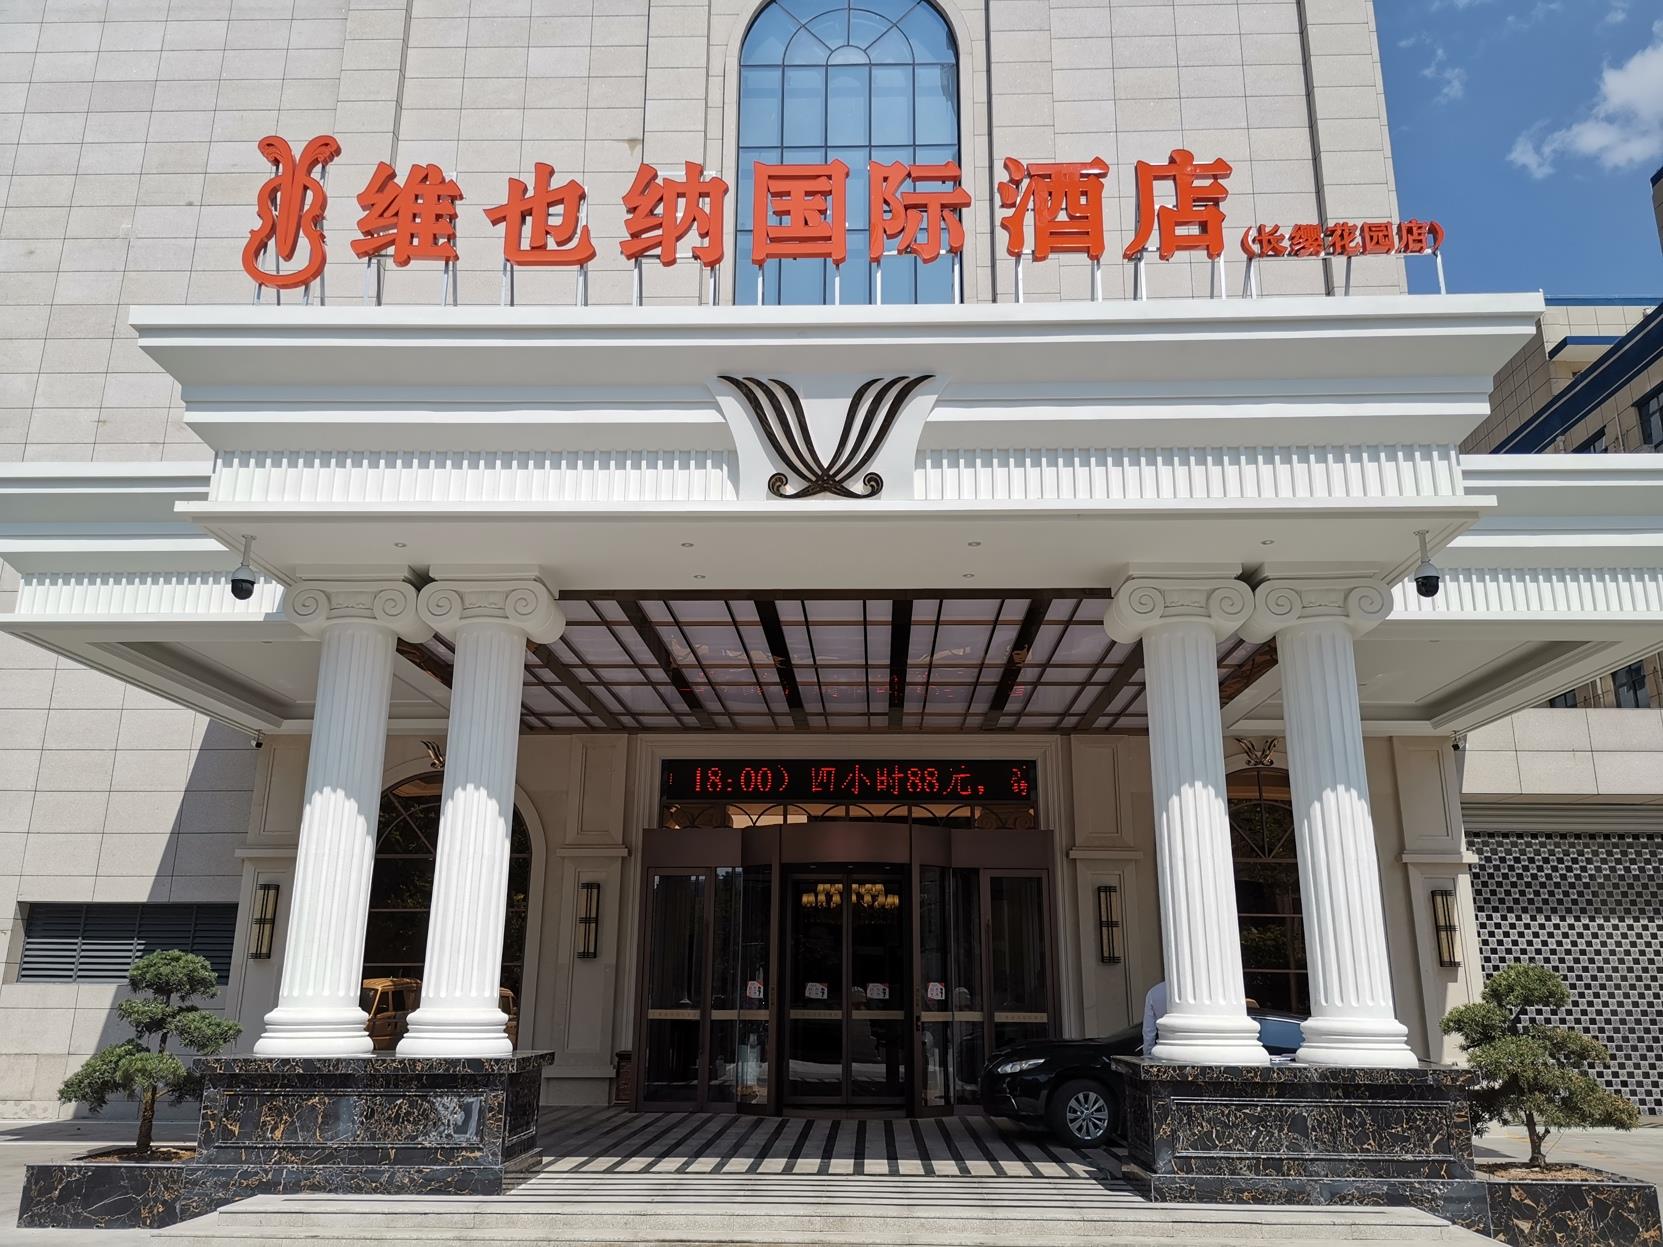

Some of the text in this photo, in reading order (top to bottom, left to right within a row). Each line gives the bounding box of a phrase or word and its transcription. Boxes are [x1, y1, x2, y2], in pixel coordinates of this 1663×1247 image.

[350, 149, 1233, 267] 维也纳国际酒店
[1240, 219, 1446, 258] （长缨花园店）
